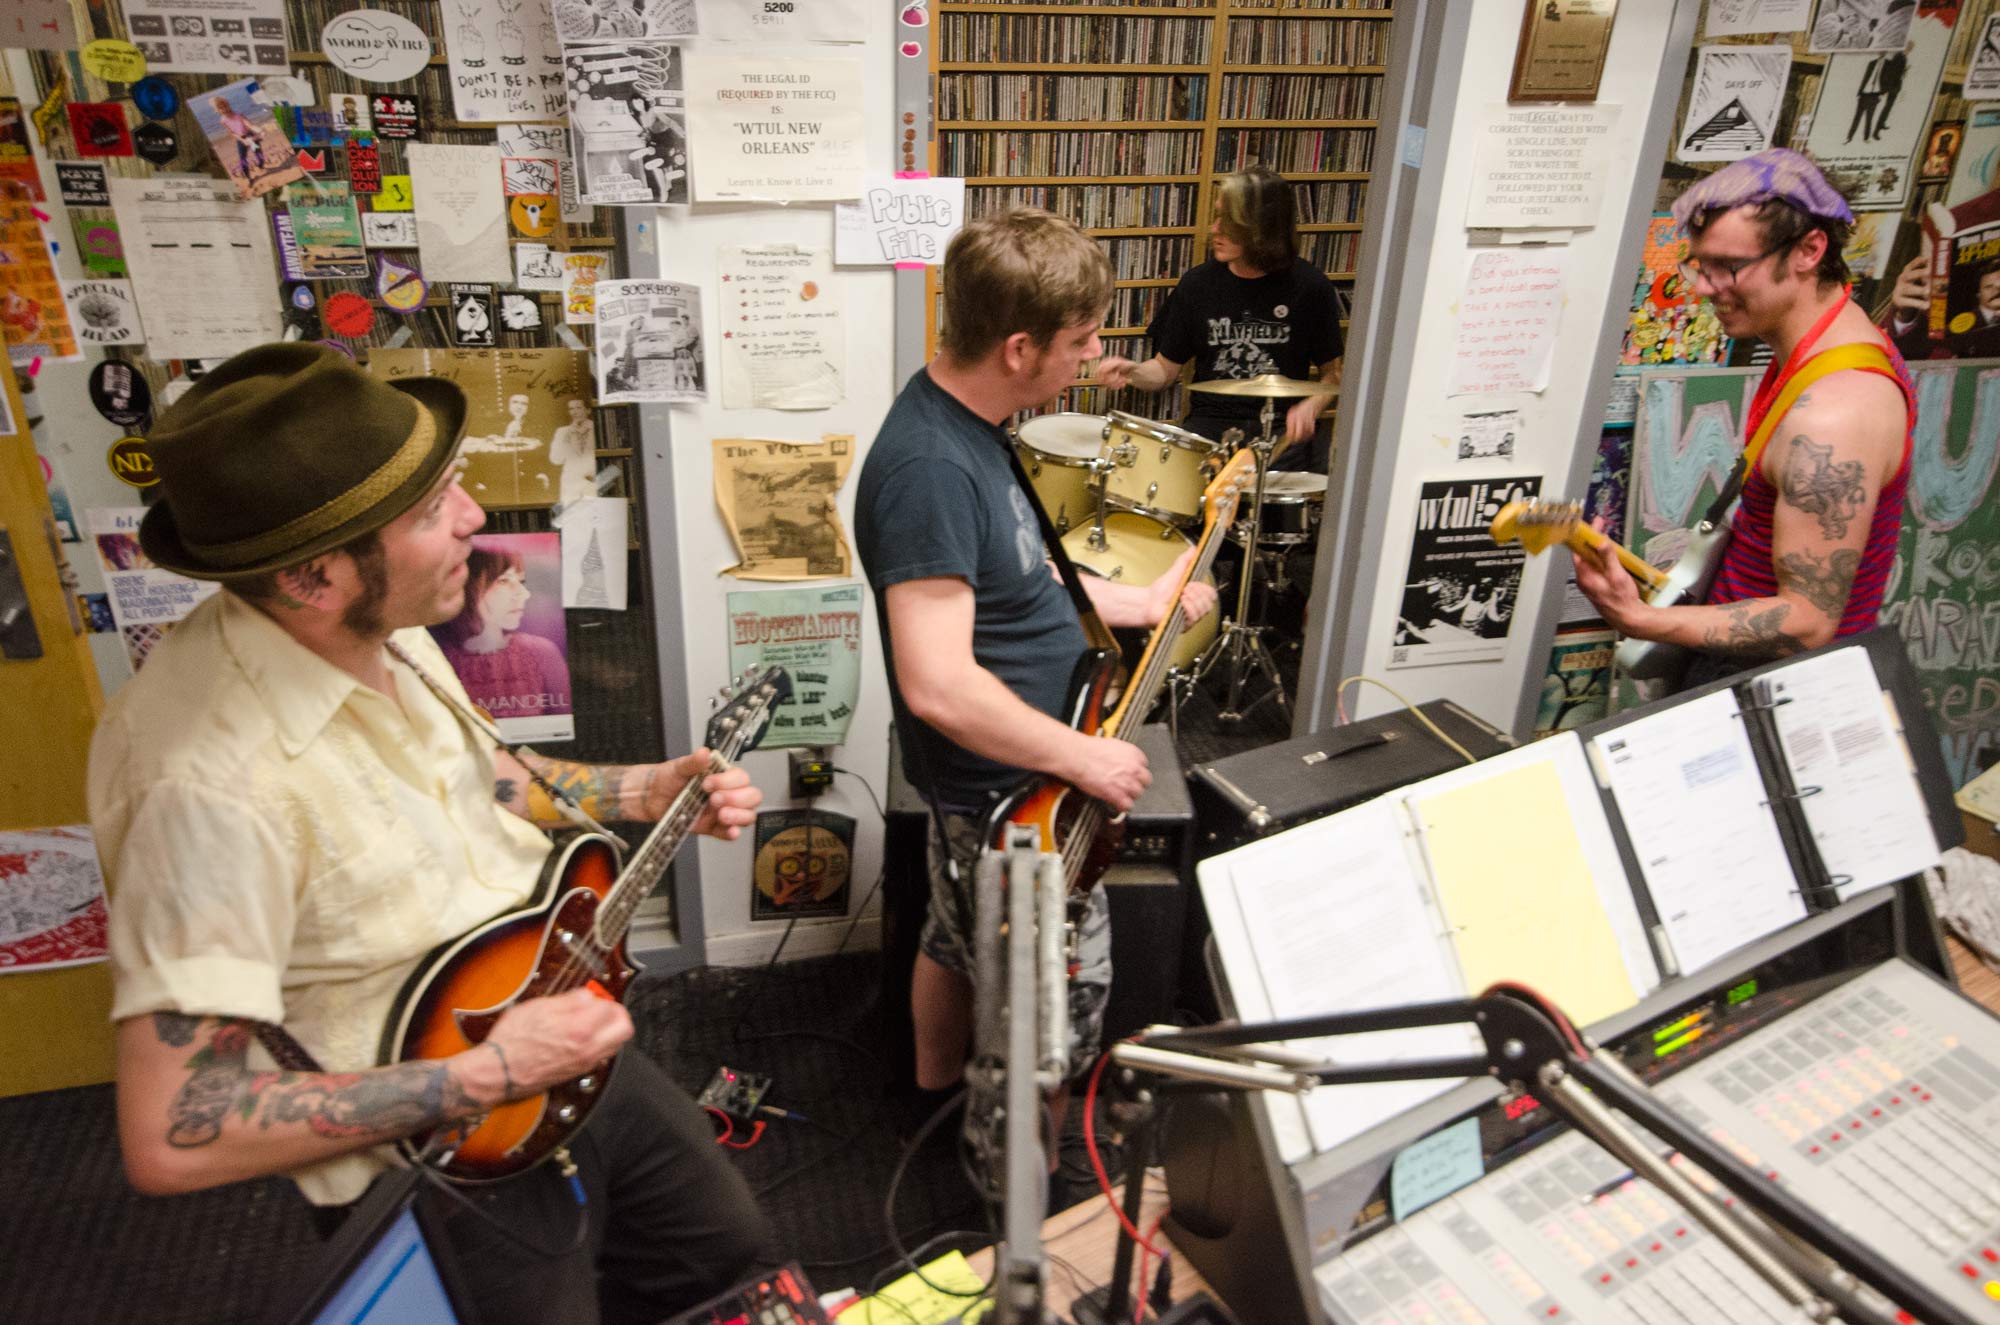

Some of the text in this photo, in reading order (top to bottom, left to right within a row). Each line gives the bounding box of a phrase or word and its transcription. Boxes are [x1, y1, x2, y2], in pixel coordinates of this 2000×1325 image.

[764, 2, 793, 13] 5200
[326, 37, 426, 50] WOOD & WIRE
[458, 72, 497, 87] DON'T
[504, 74, 522, 87] BE
[527, 76, 537, 87] A
[742, 74, 811, 84] THE LEGAL ID
[1725, 80, 1764, 89] DAYS OFF
[473, 88, 497, 99] PLAY
[717, 90, 836, 100] (REQUIRED BY THE FCC)
[771, 106, 784, 114] IS:
[1508, 112, 1593, 122] THE LEGAL WAY TO
[788, 122, 822, 134] NEW
[1489, 125, 1529, 134] CORRECT
[1532, 125, 1575, 134] MISTAKES
[1586, 125, 1607, 134] WITH
[1515, 137, 1545, 145] SINGLE
[1571, 137, 1588, 145] NOT
[1509, 161, 1532, 169] THEN
[1534, 161, 1561, 169] WRITE
[727, 178, 754, 187] Learn
[767, 178, 793, 187] Know
[806, 178, 824, 187] Live
[869, 188, 951, 227] Public
[877, 227, 936, 262] File
[66, 284, 129, 301] SPECIAL
[80, 327, 131, 342] HEAD
[723, 446, 758, 458] The
[1419, 484, 1481, 531] wtul
[477, 692, 570, 711] MANDELL
